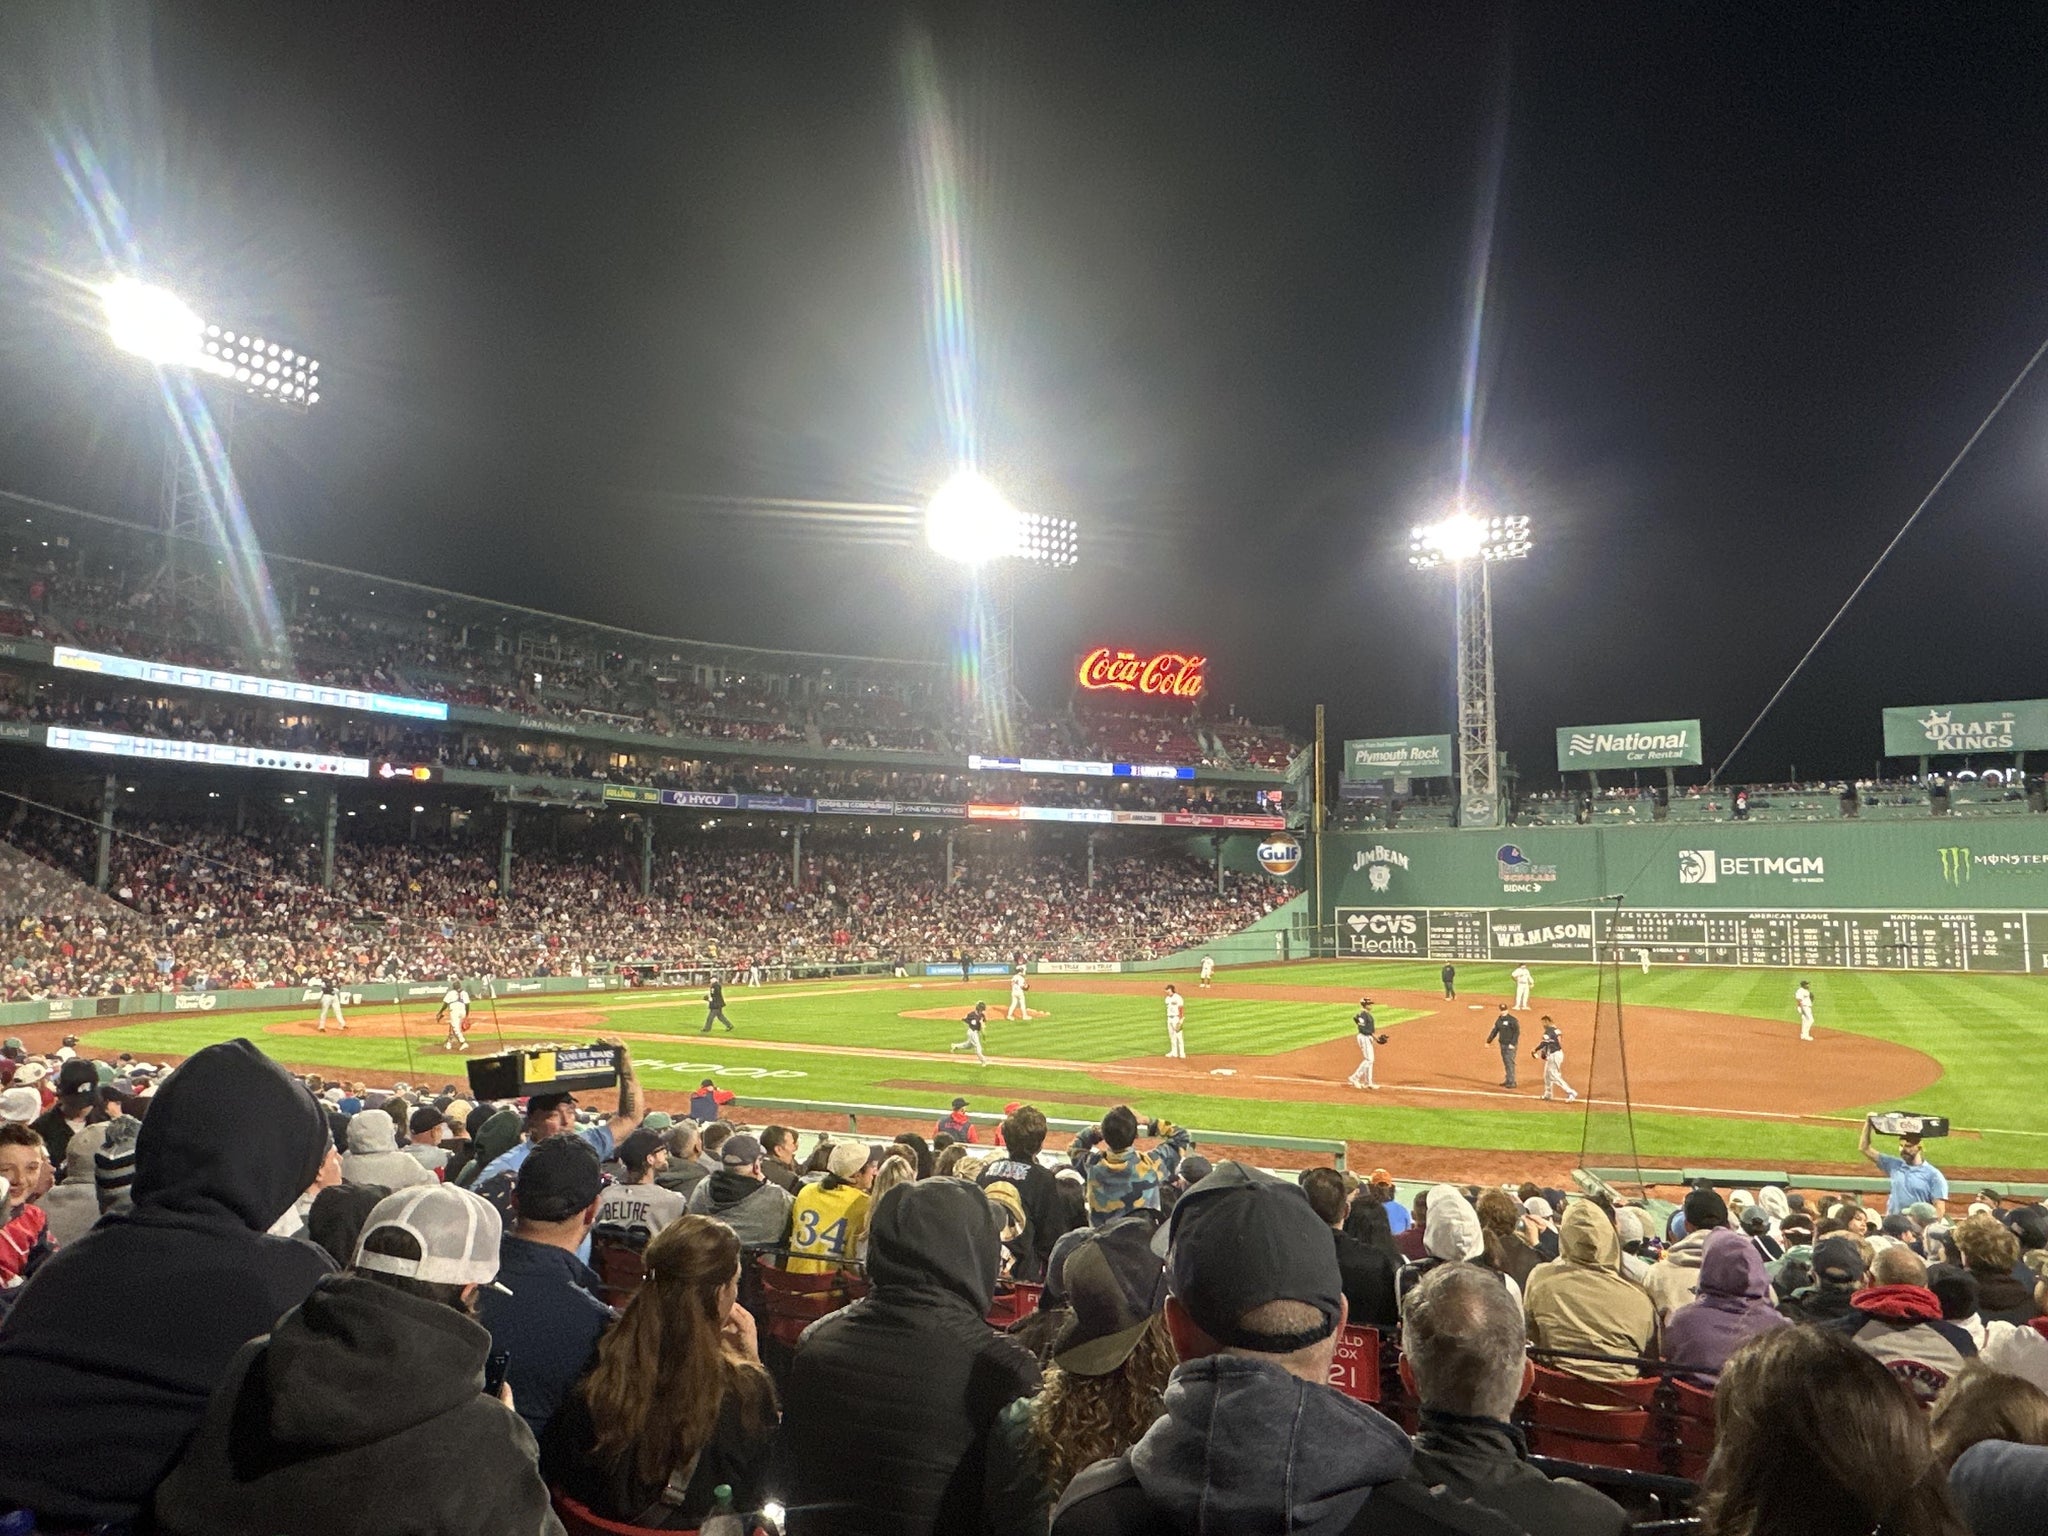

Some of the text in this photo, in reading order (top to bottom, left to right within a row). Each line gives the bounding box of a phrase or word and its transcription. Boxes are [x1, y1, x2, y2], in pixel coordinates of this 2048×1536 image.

[1925, 721, 2015, 740] DRAFT
[1595, 730, 1687, 752] National
[1937, 735, 2014, 751] KINGS
[1355, 746, 1439, 764] Plymouth Rock
[1627, 750, 1683, 760] Car Rental
[689, 795, 721, 805] HYCU
[904, 805, 965, 815] VINEYARD VINES
[1260, 846, 1297, 860] Gulf
[1353, 845, 1409, 871] JIM BEAM
[1720, 857, 1824, 874] BETMGM
[1503, 884, 1532, 892] BIDMC
[1369, 914, 1417, 934] CVS
[1350, 935, 1418, 953] Health
[558, 1049, 615, 1062] SAMUEL ADAMS
[562, 1058, 611, 1070] SUMMER ALE
[604, 1201, 650, 1222] BELTRE
[797, 1209, 848, 1253] 34
[1334, 1347, 1358, 1359] OX
[1328, 1364, 1356, 1388] 21
